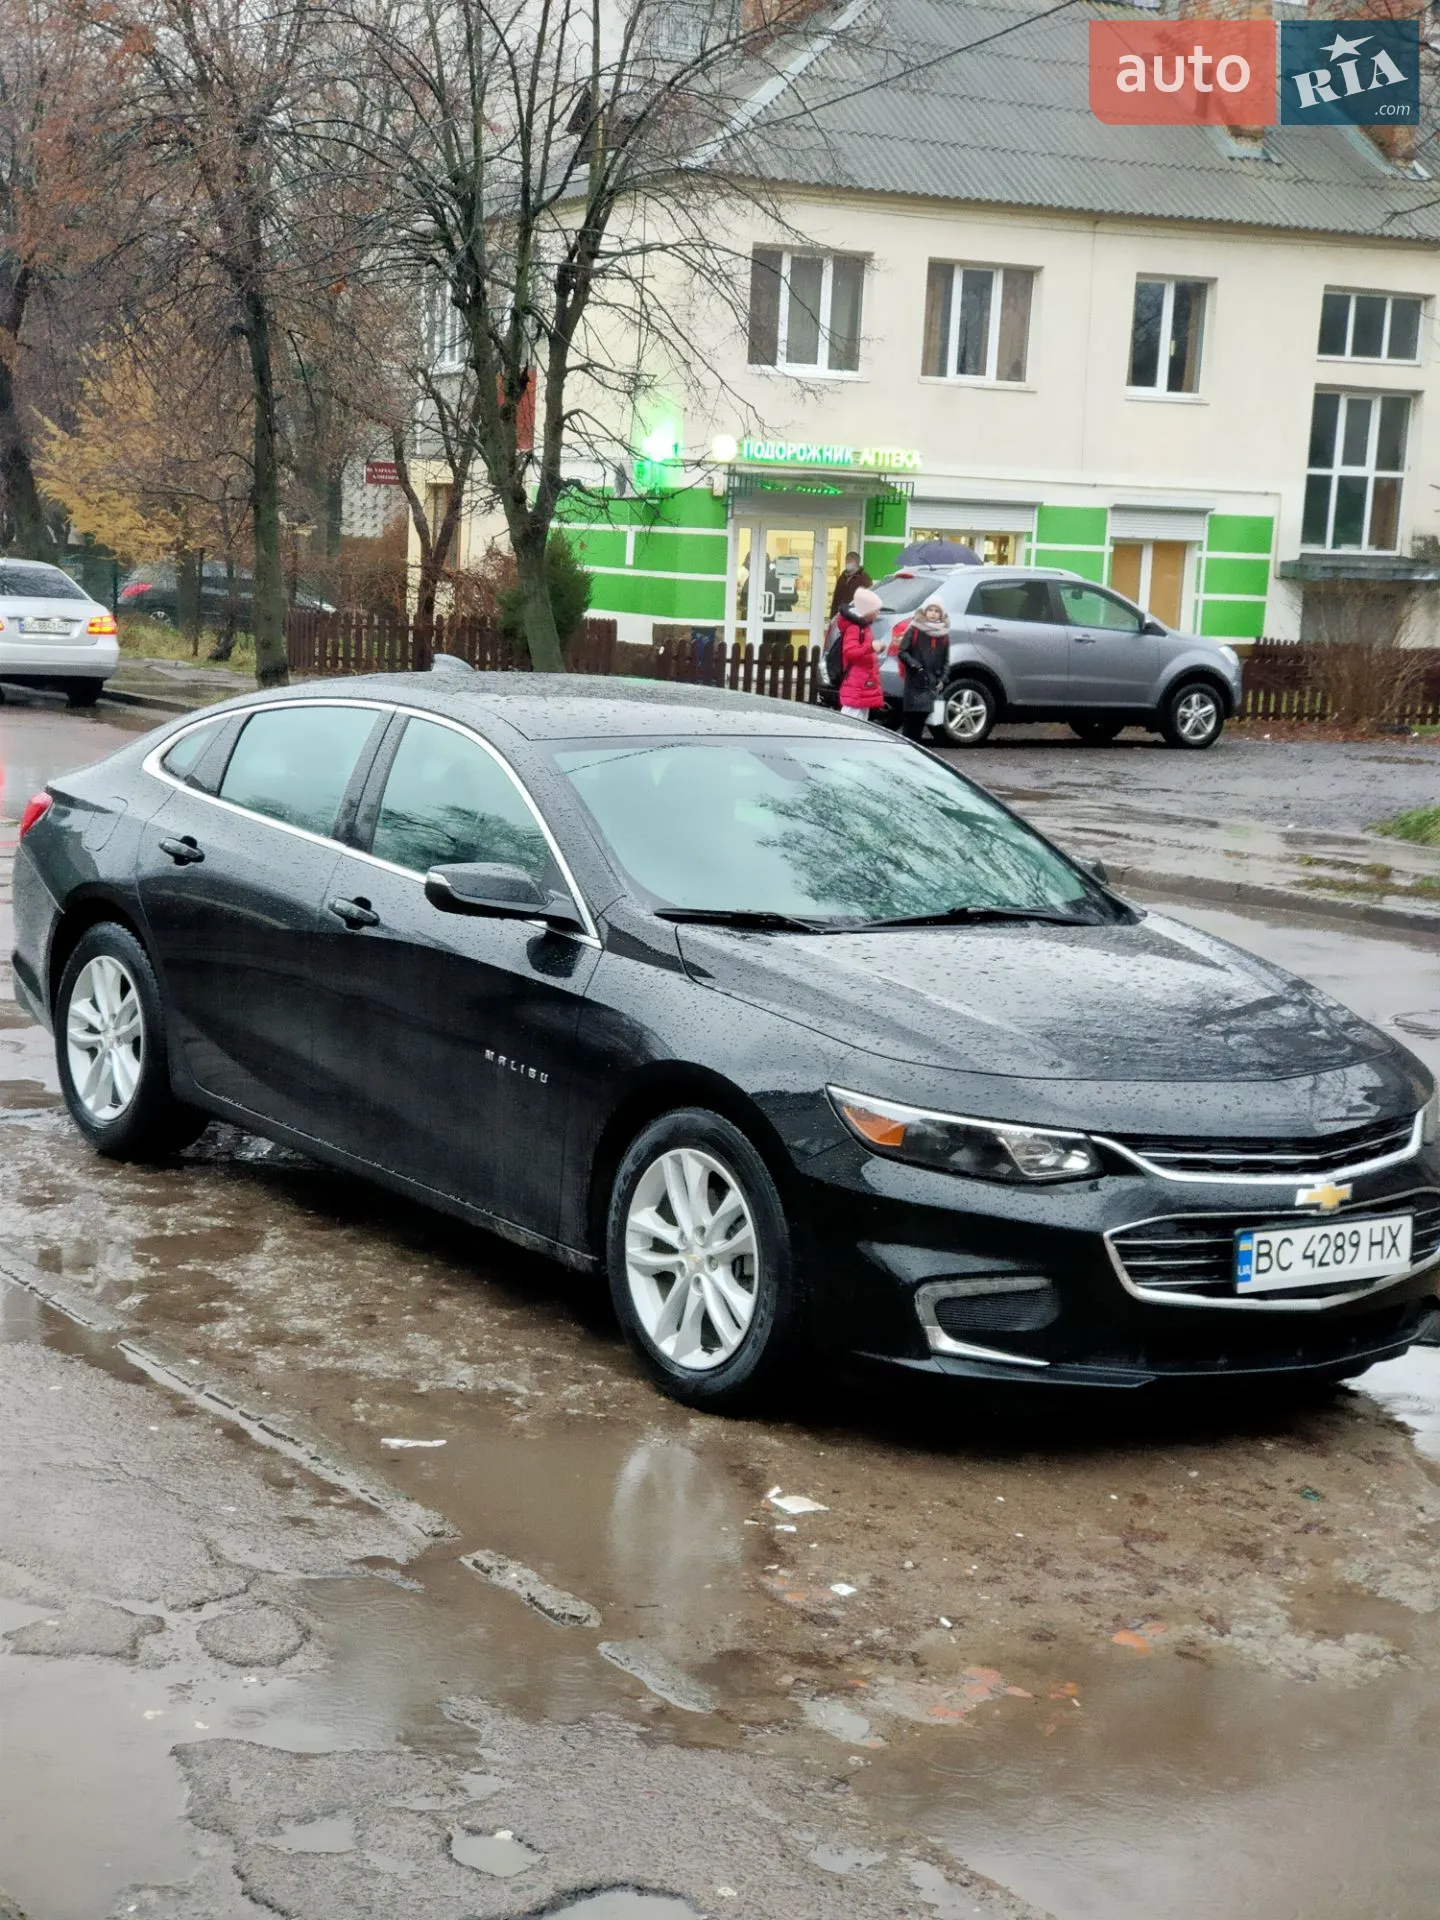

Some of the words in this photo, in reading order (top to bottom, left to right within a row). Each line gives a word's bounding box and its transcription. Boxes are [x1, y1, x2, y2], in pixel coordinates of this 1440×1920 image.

[743, 439, 854, 464] ПОДОРОЖНИК
[859, 448, 922, 469] АПТЕКА
[485, 1049, 549, 1084] MALIBU
[1255, 1237, 1294, 1275] BC
[1302, 1230, 1361, 1269] 4289
[1368, 1223, 1403, 1262] HX
